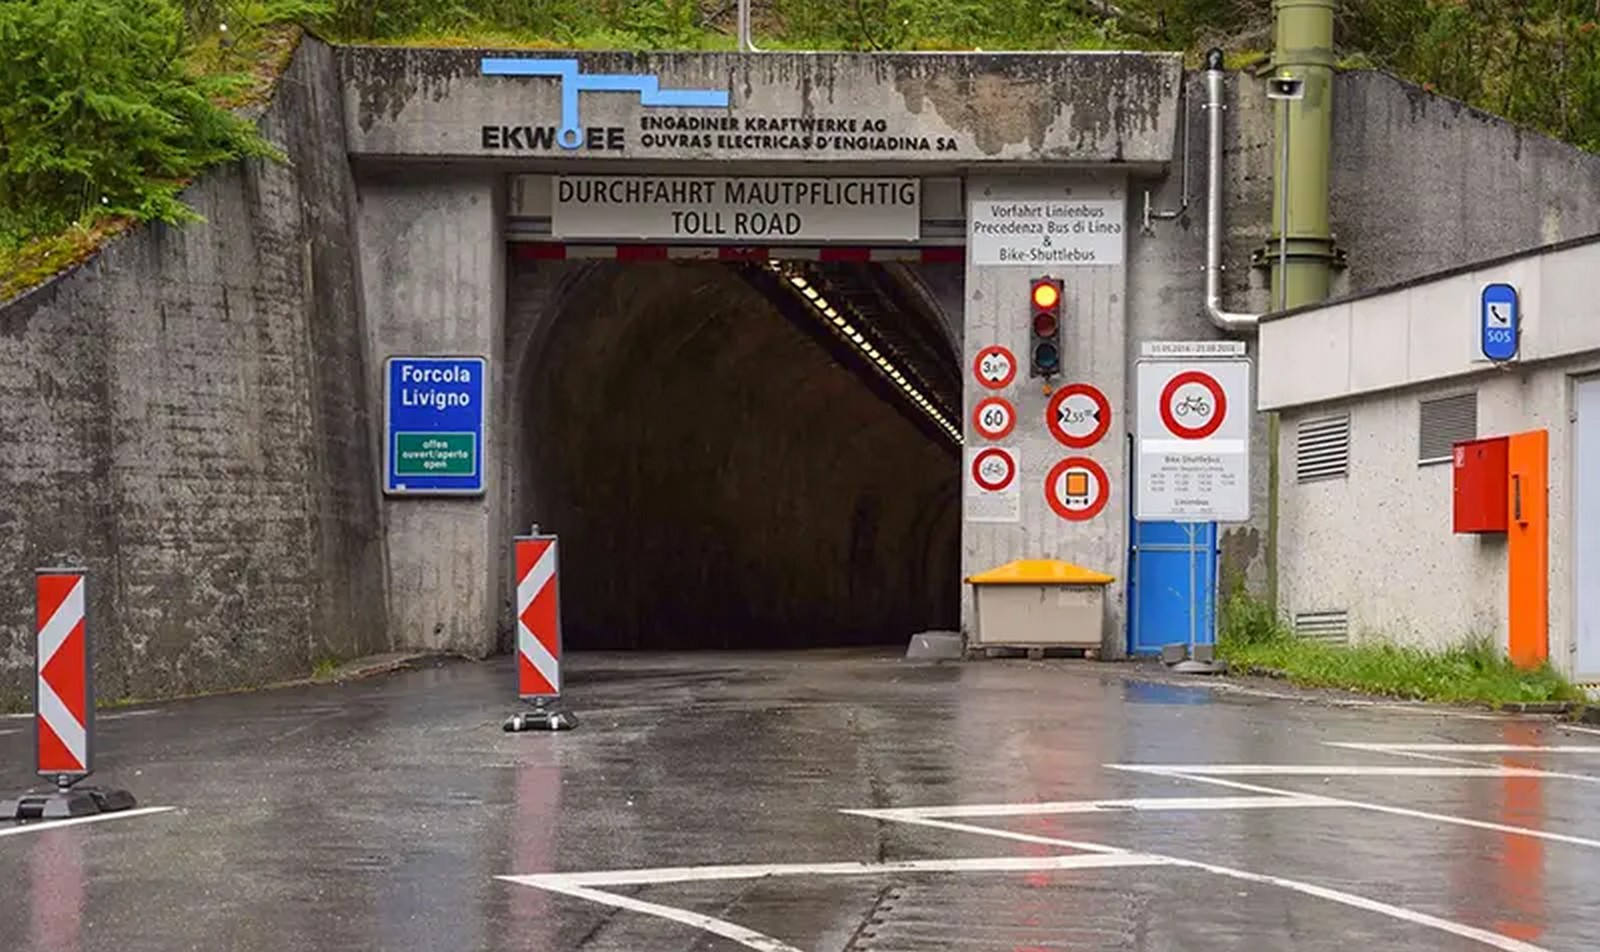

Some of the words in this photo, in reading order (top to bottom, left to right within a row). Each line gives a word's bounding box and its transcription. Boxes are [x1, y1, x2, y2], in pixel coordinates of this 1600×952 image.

[640, 117, 739, 131] ENGADINER
[745, 118, 857, 133] KRAFTWERKE
[862, 119, 888, 132] AG
[641, 134, 712, 148] OUVRAS
[717, 135, 811, 150] ELECTRICAS
[936, 137, 958, 151] SA
[559, 180, 716, 203] DURCHFAHRT
[724, 181, 915, 205] MAUTPFLICHTIG
[991, 204, 1042, 217] Vorfahrt
[1045, 205, 1104, 218] Linienbus
[672, 211, 726, 234] TOLL
[735, 212, 801, 235] ROAD
[974, 221, 1043, 234] Precedenza
[1047, 221, 1069, 234] Bus
[1072, 221, 1085, 234] di
[1088, 222, 1121, 234] Linea
[1043, 236, 1052, 247] &
[999, 248, 1095, 261] Bike-Shuttlebus
[1488, 330, 1511, 342] SOS
[402, 365, 471, 383] Forcola
[402, 388, 470, 410] Livigno
[984, 410, 1003, 426] 60
[423, 460, 448, 470] open
